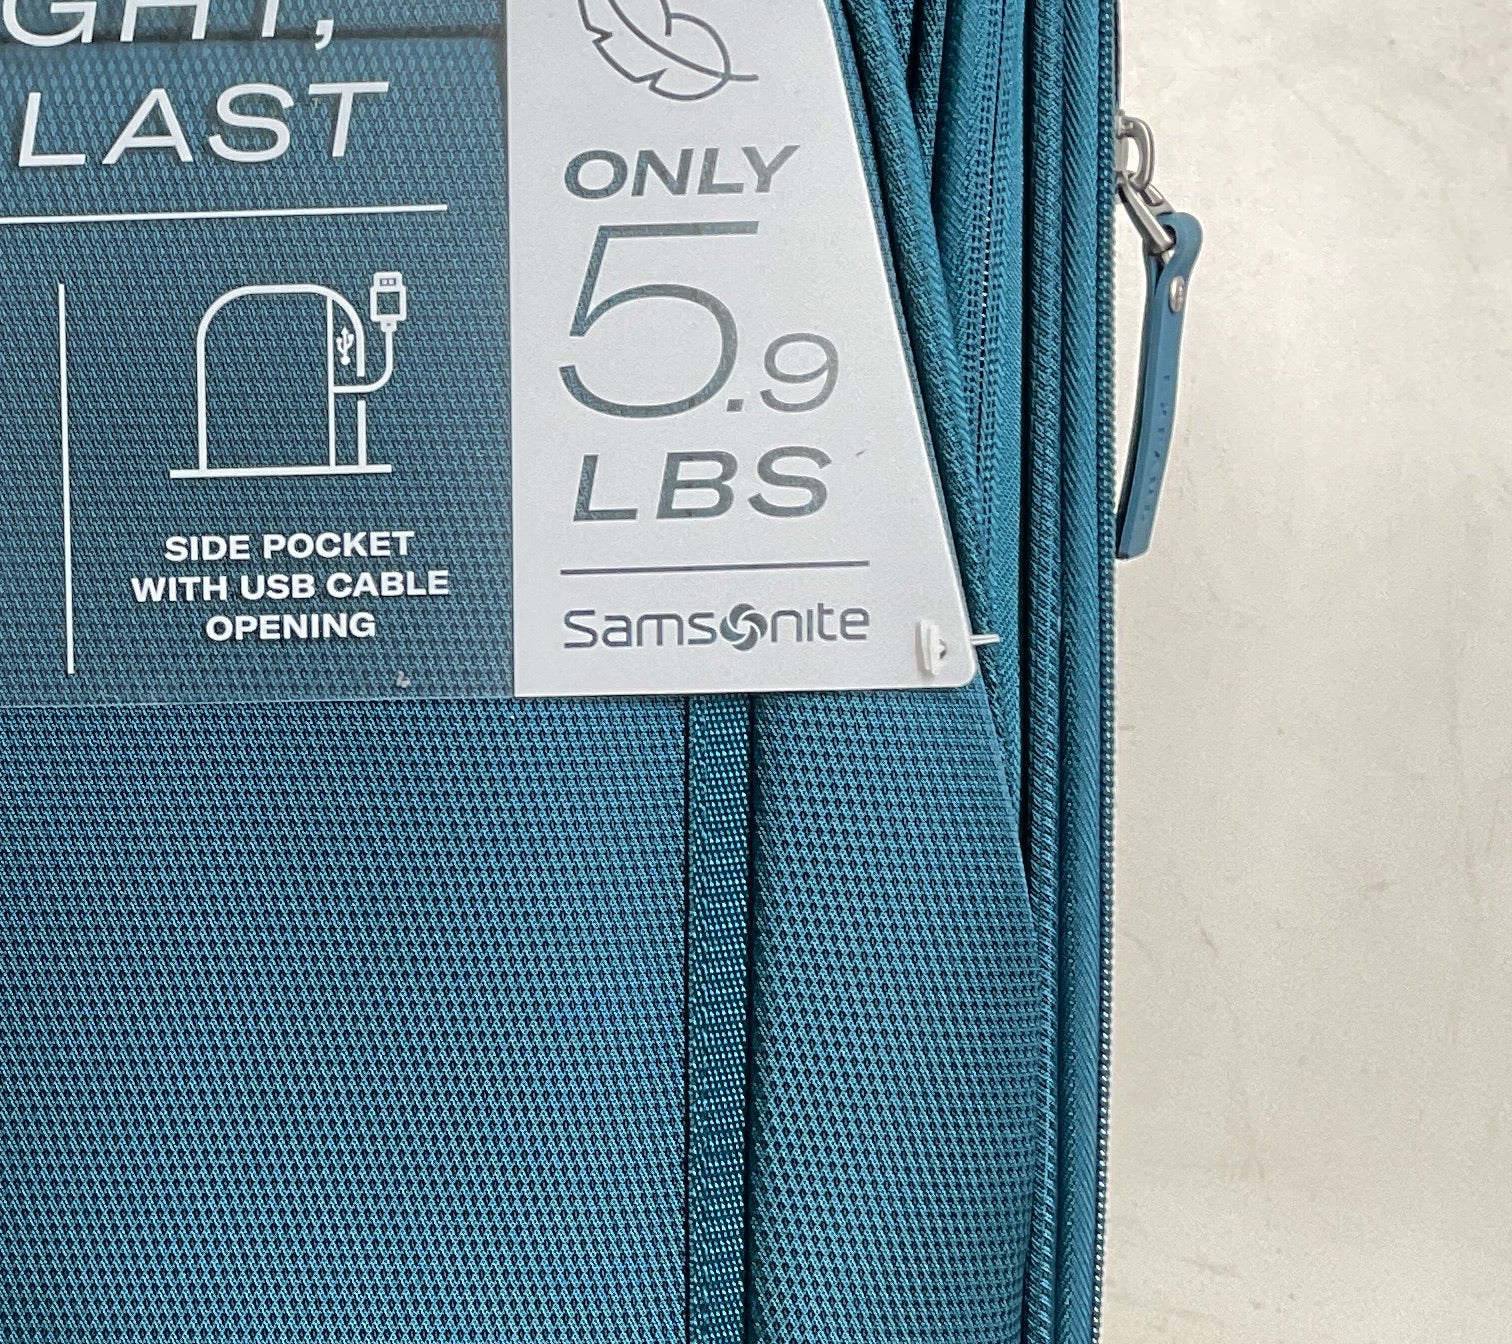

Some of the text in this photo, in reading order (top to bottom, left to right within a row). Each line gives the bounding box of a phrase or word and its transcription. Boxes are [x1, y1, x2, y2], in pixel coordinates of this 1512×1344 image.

[18, 81, 390, 167] LAST
[563, 144, 801, 200] ONLY
[558, 220, 839, 419] 5.9
[572, 445, 833, 522] LBS
[164, 530, 415, 562] SIDE POCKET
[130, 569, 451, 603] WITH USB CABLE
[205, 611, 376, 641] OPENING
[563, 602, 870, 651] Samsonite
